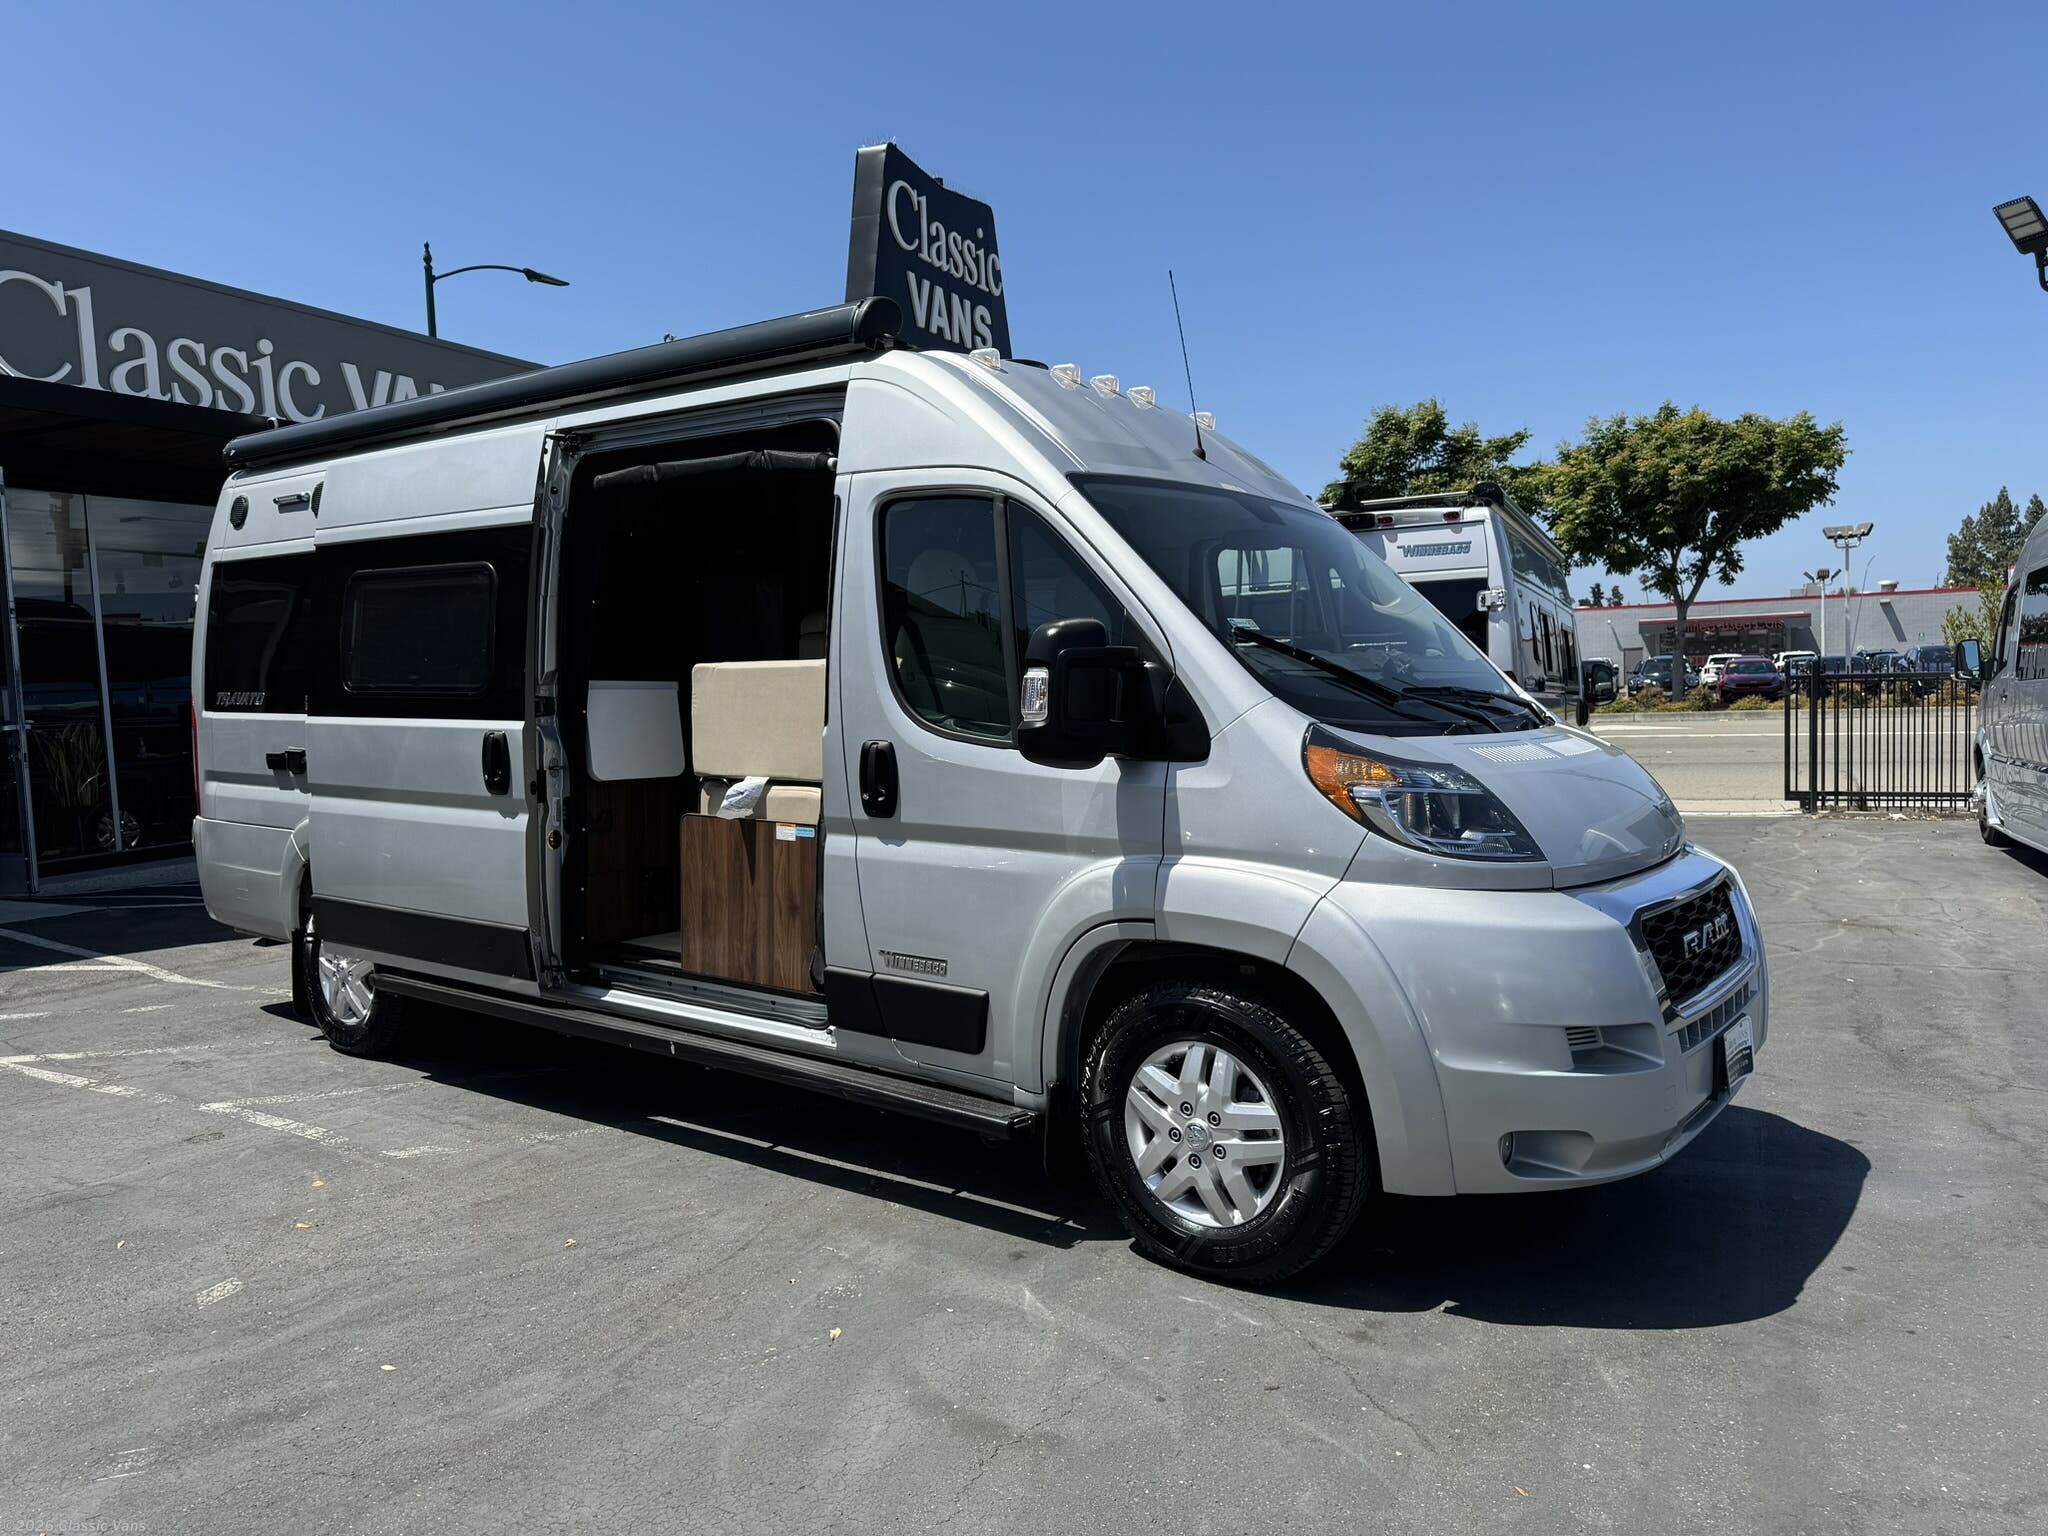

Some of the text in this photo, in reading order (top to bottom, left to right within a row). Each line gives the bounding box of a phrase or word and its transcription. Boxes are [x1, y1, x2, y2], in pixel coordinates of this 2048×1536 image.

[887, 180, 1002, 297] Classic
[907, 271, 993, 350] VANS
[0, 269, 326, 422] Classic
[1397, 541, 1472, 558] WINNEBAGO
[879, 949, 948, 977] WINNEBAGO
[1683, 912, 1730, 959] RAM
